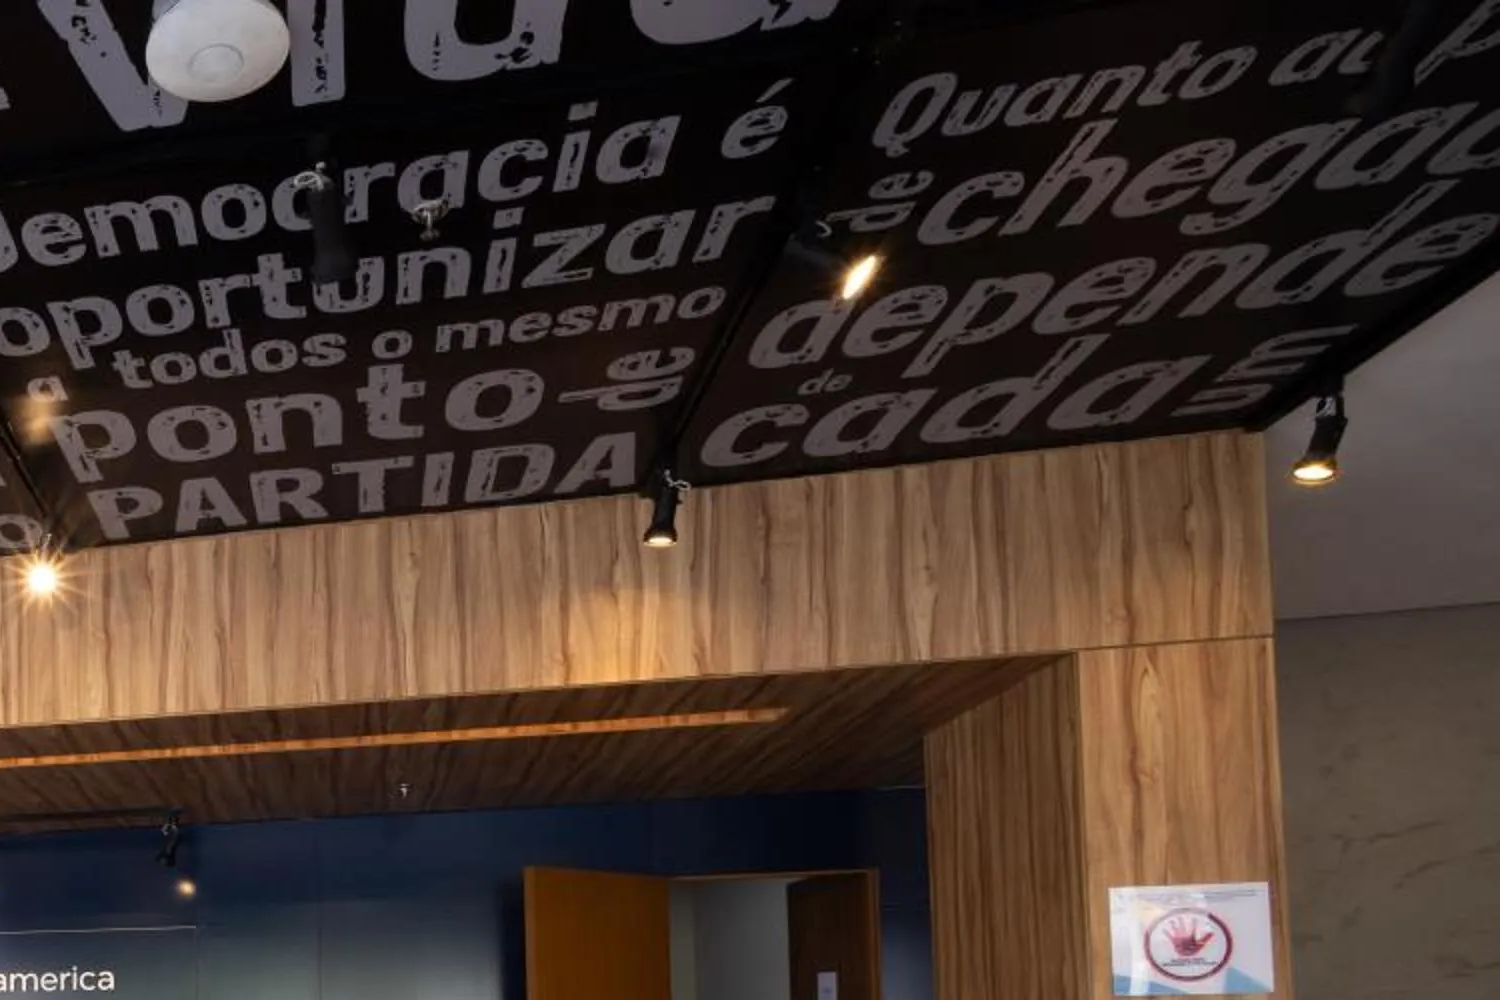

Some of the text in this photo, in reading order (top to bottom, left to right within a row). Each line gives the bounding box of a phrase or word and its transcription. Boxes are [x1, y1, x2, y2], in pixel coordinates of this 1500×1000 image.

[721, 78, 795, 160] é
[871, 40, 1258, 158] Quanto
[825, 169, 936, 233] de
[748, 178, 1499, 378] depende
[112, 285, 726, 390] todos o mesmo
[558, 345, 696, 412] de
[799, 368, 853, 396] de
[26, 363, 545, 484] a ponto
[700, 333, 1211, 467] cada
[87, 432, 637, 541] PARTIDA
